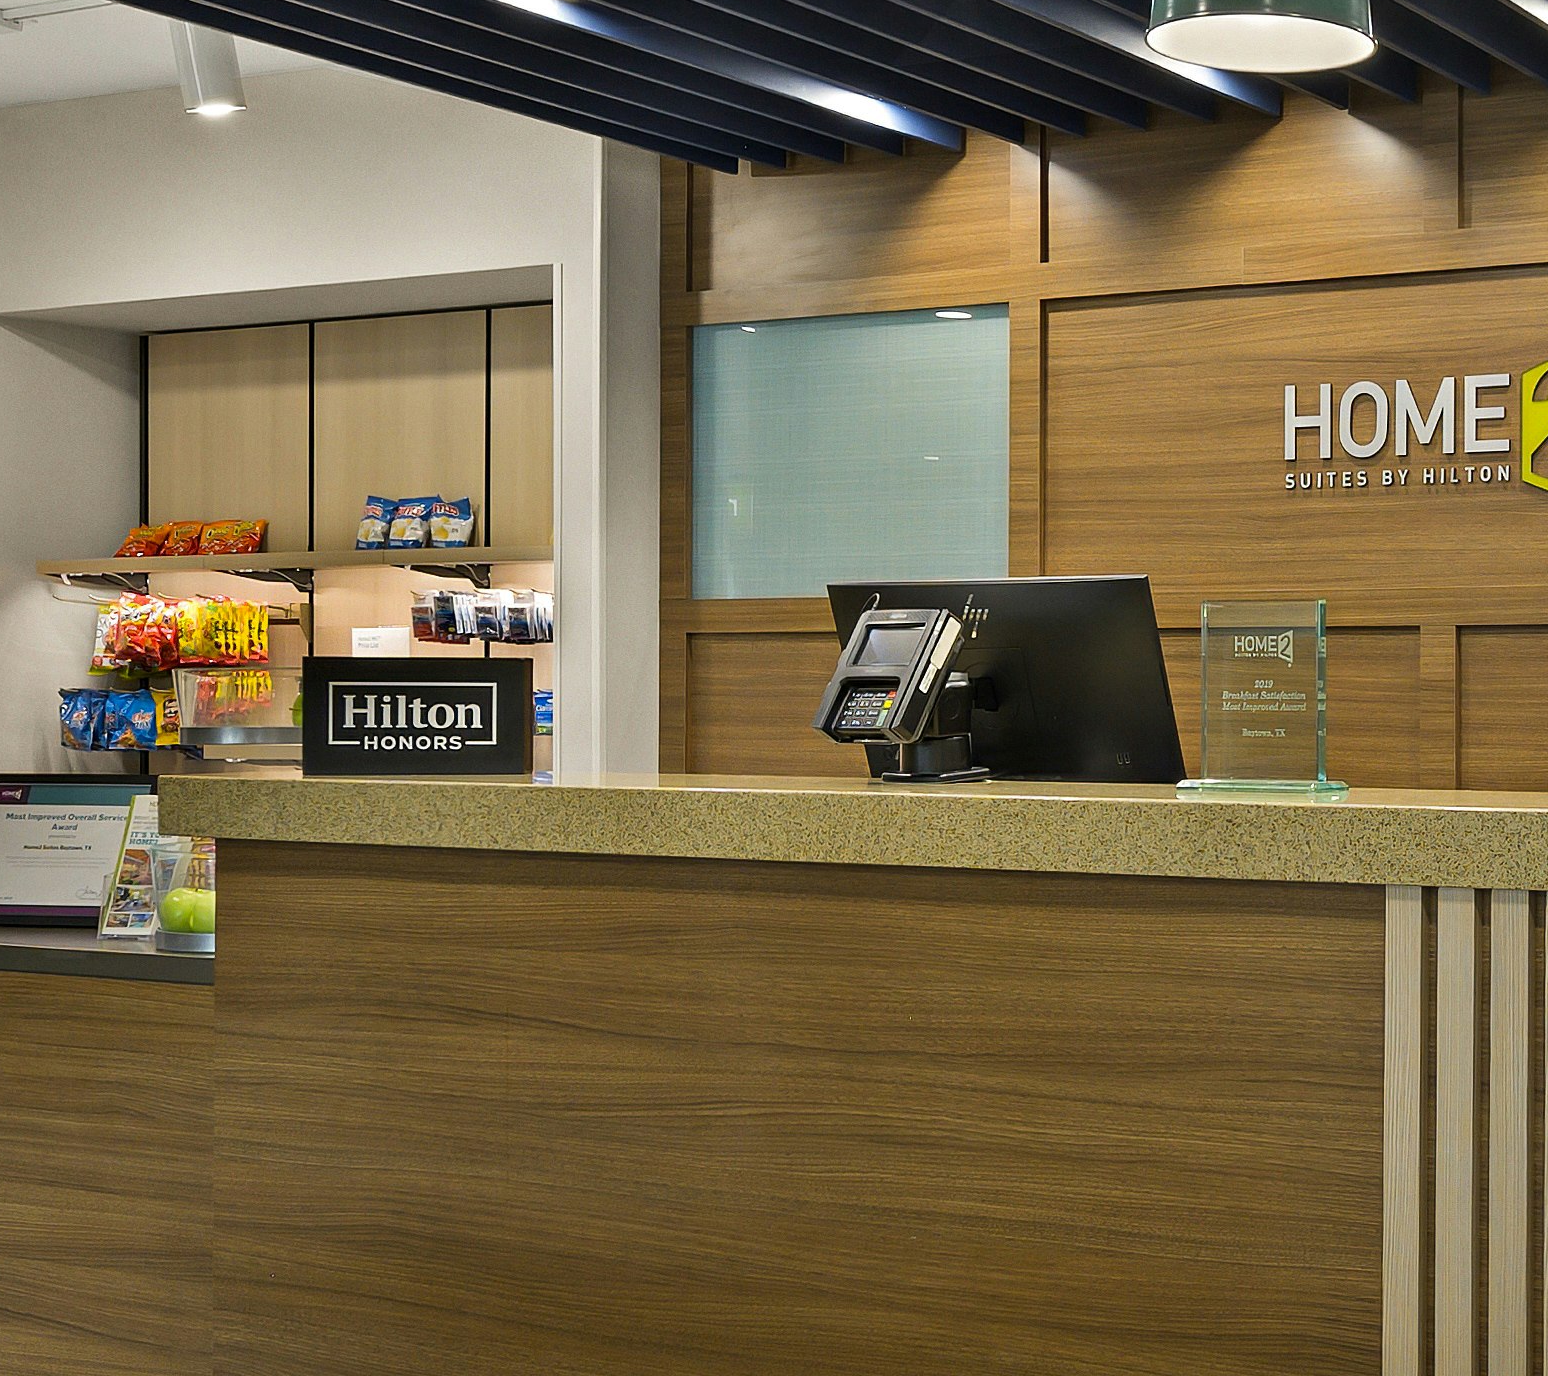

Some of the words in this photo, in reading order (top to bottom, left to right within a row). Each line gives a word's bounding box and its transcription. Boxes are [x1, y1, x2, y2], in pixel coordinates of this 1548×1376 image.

[1284, 470, 1368, 490] SUITES
[1382, 469, 1409, 486] BY
[1423, 465, 1510, 484] HILTON
[1222, 690, 1259, 701] Breakfast
[1260, 690, 1306, 701] Satisfaction
[341, 694, 484, 729] Hilton
[363, 735, 463, 750] HONORS
